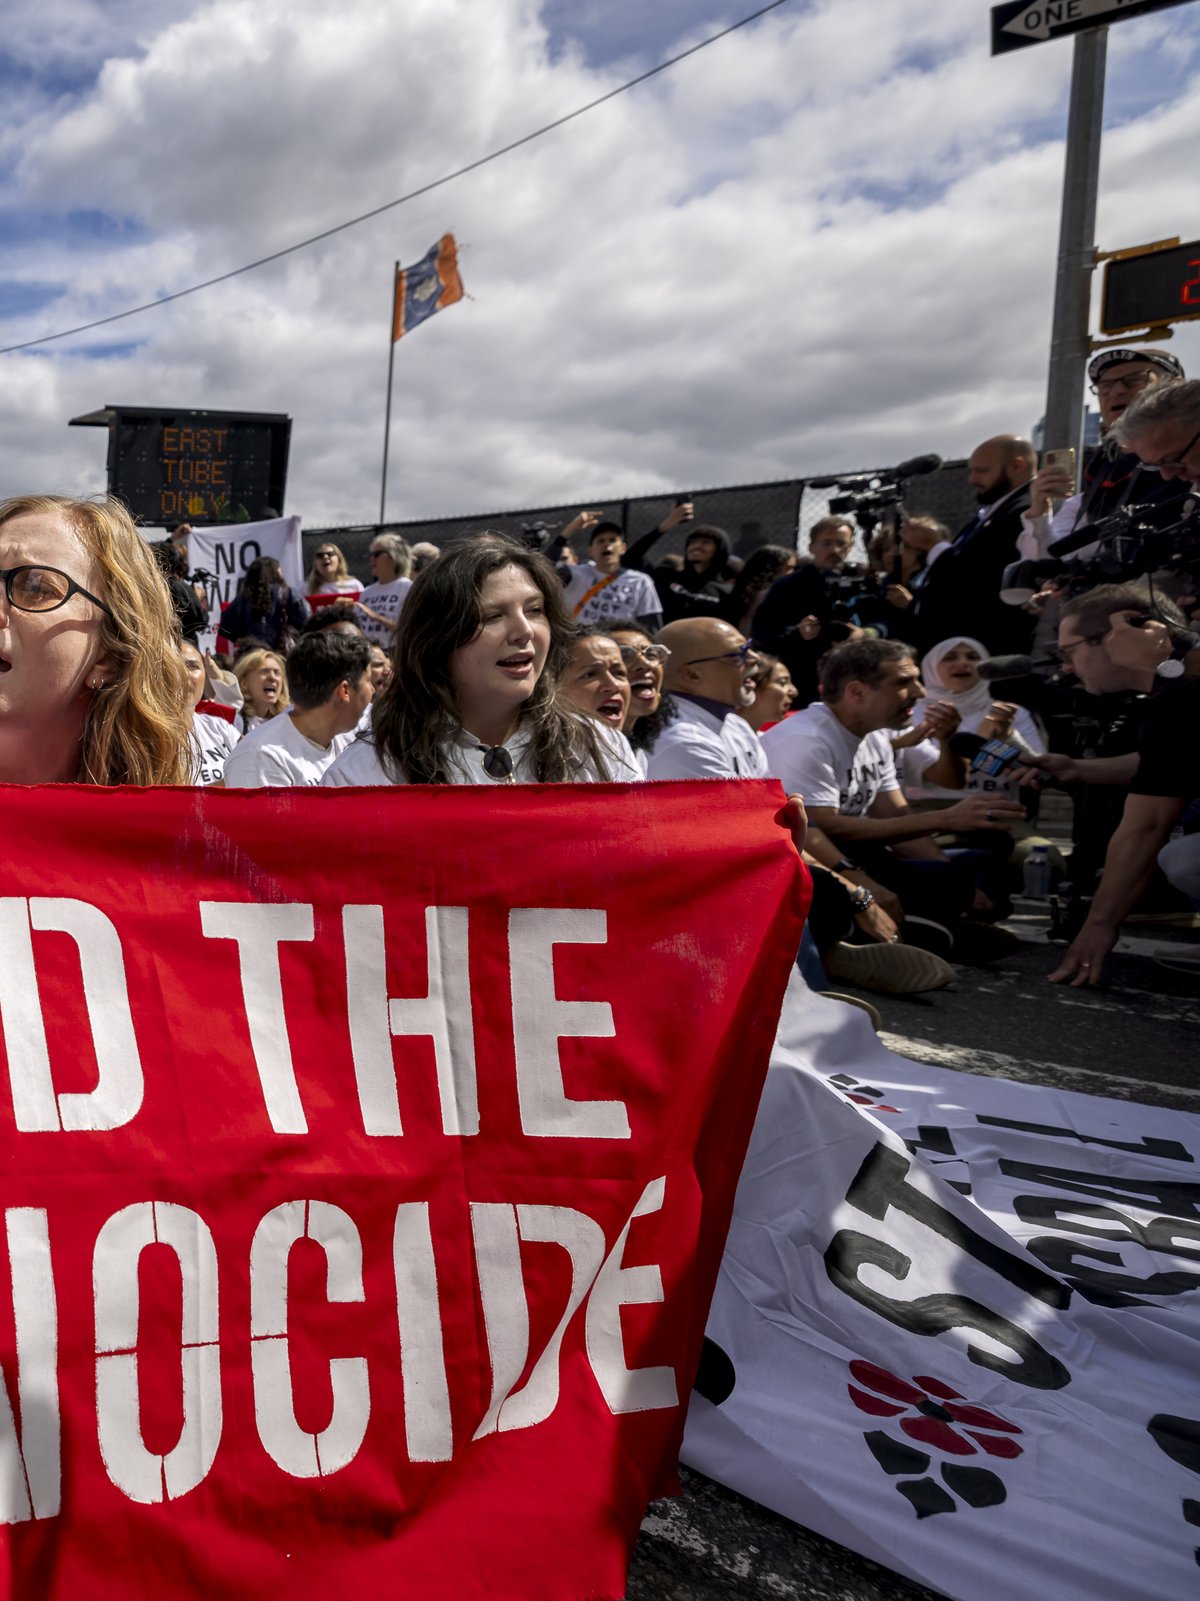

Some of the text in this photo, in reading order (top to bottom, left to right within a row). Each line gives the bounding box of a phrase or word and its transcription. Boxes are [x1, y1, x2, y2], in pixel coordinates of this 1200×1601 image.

[1024, 1, 1082, 30] ONE
[163, 427, 228, 453] EAST
[162, 458, 227, 484] TUBE
[161, 490, 226, 515] ONLY
[215, 540, 262, 575] NO
[200, 902, 631, 1138] THE
